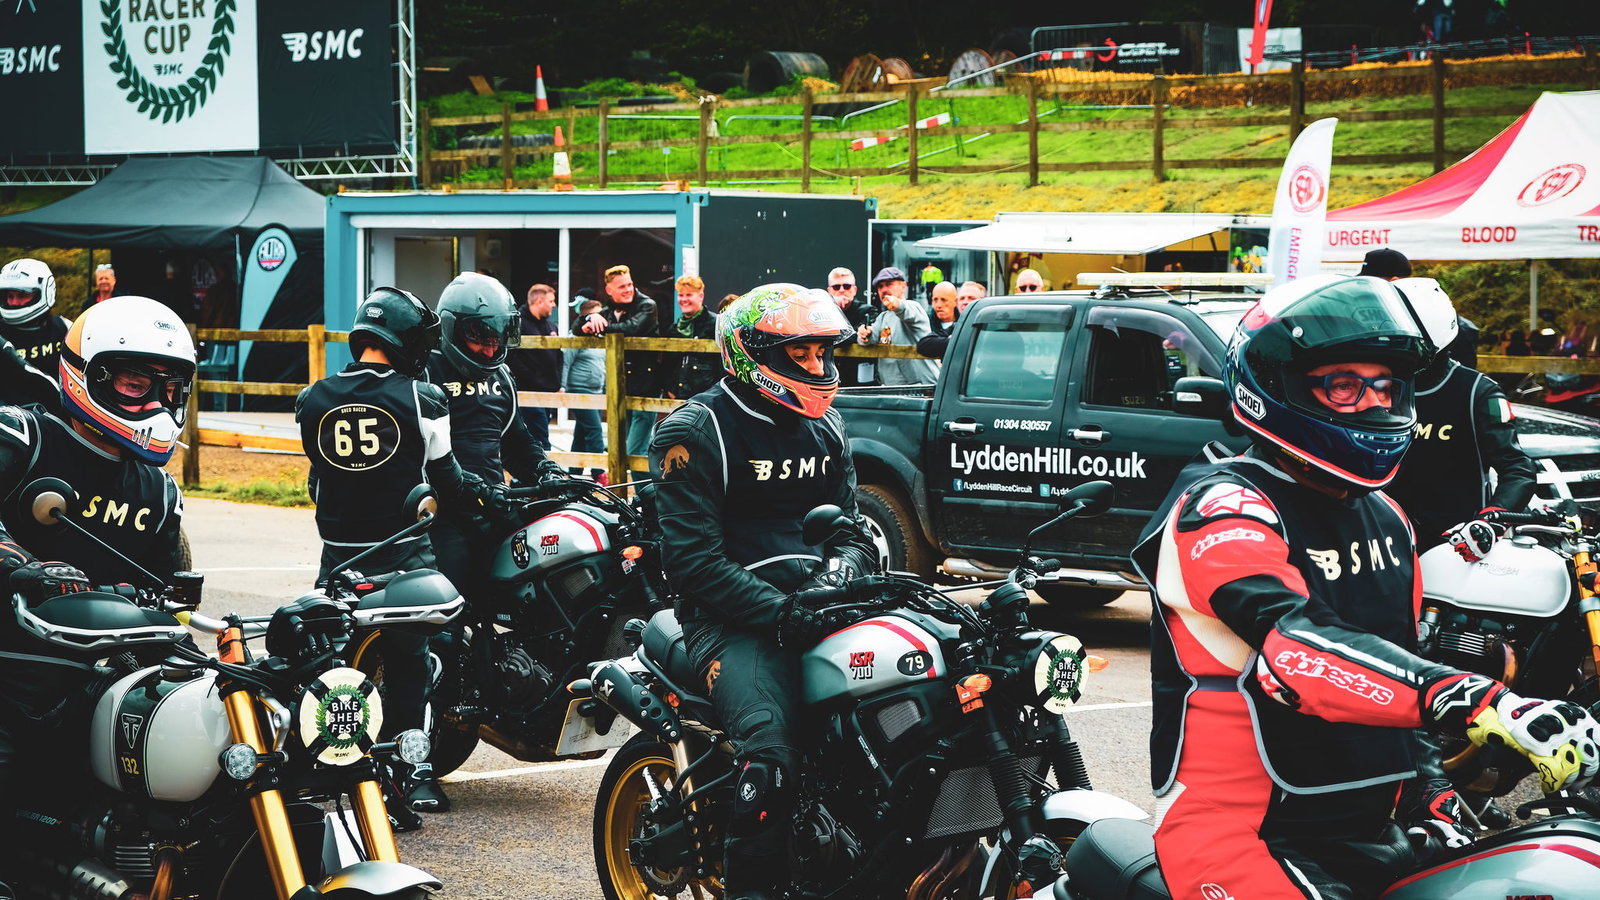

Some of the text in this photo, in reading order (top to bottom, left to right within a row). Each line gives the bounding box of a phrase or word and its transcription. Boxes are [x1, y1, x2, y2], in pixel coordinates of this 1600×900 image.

[129, 0, 206, 22] RACER
[143, 23, 191, 54] CUP
[280, 28, 364, 63] BSMC
[0, 45, 62, 75] BSMC
[152, 62, 184, 76] BSMC
[1329, 224, 1600, 246] URGENT BLOOD TR
[442, 381, 502, 397] BSMC
[755, 372, 781, 393] SHOEI
[1238, 387, 1261, 415] SHOEI
[993, 419, 1052, 431] 01304 830557
[1414, 423, 1453, 440] MC
[334, 418, 380, 457] 65
[951, 442, 1147, 479] LyddenHill.co.uk
[1050, 486, 1071, 497] /Lydd
[75, 490, 150, 531] SMC
[540, 534, 560, 547] XSR
[1190, 527, 1266, 560] alpinestars
[1305, 536, 1401, 581] BSMC
[849, 651, 875, 668] XSR
[905, 655, 925, 672] 79
[1058, 661, 1077, 672] BIKE
[850, 666, 873, 680] 700
[1274, 650, 1394, 705] alpinestars
[1055, 679, 1075, 689] FEST
[331, 700, 359, 712] BIKE
[330, 711, 360, 723] SHED
[331, 722, 358, 734] FEST
[121, 756, 139, 774] 132
